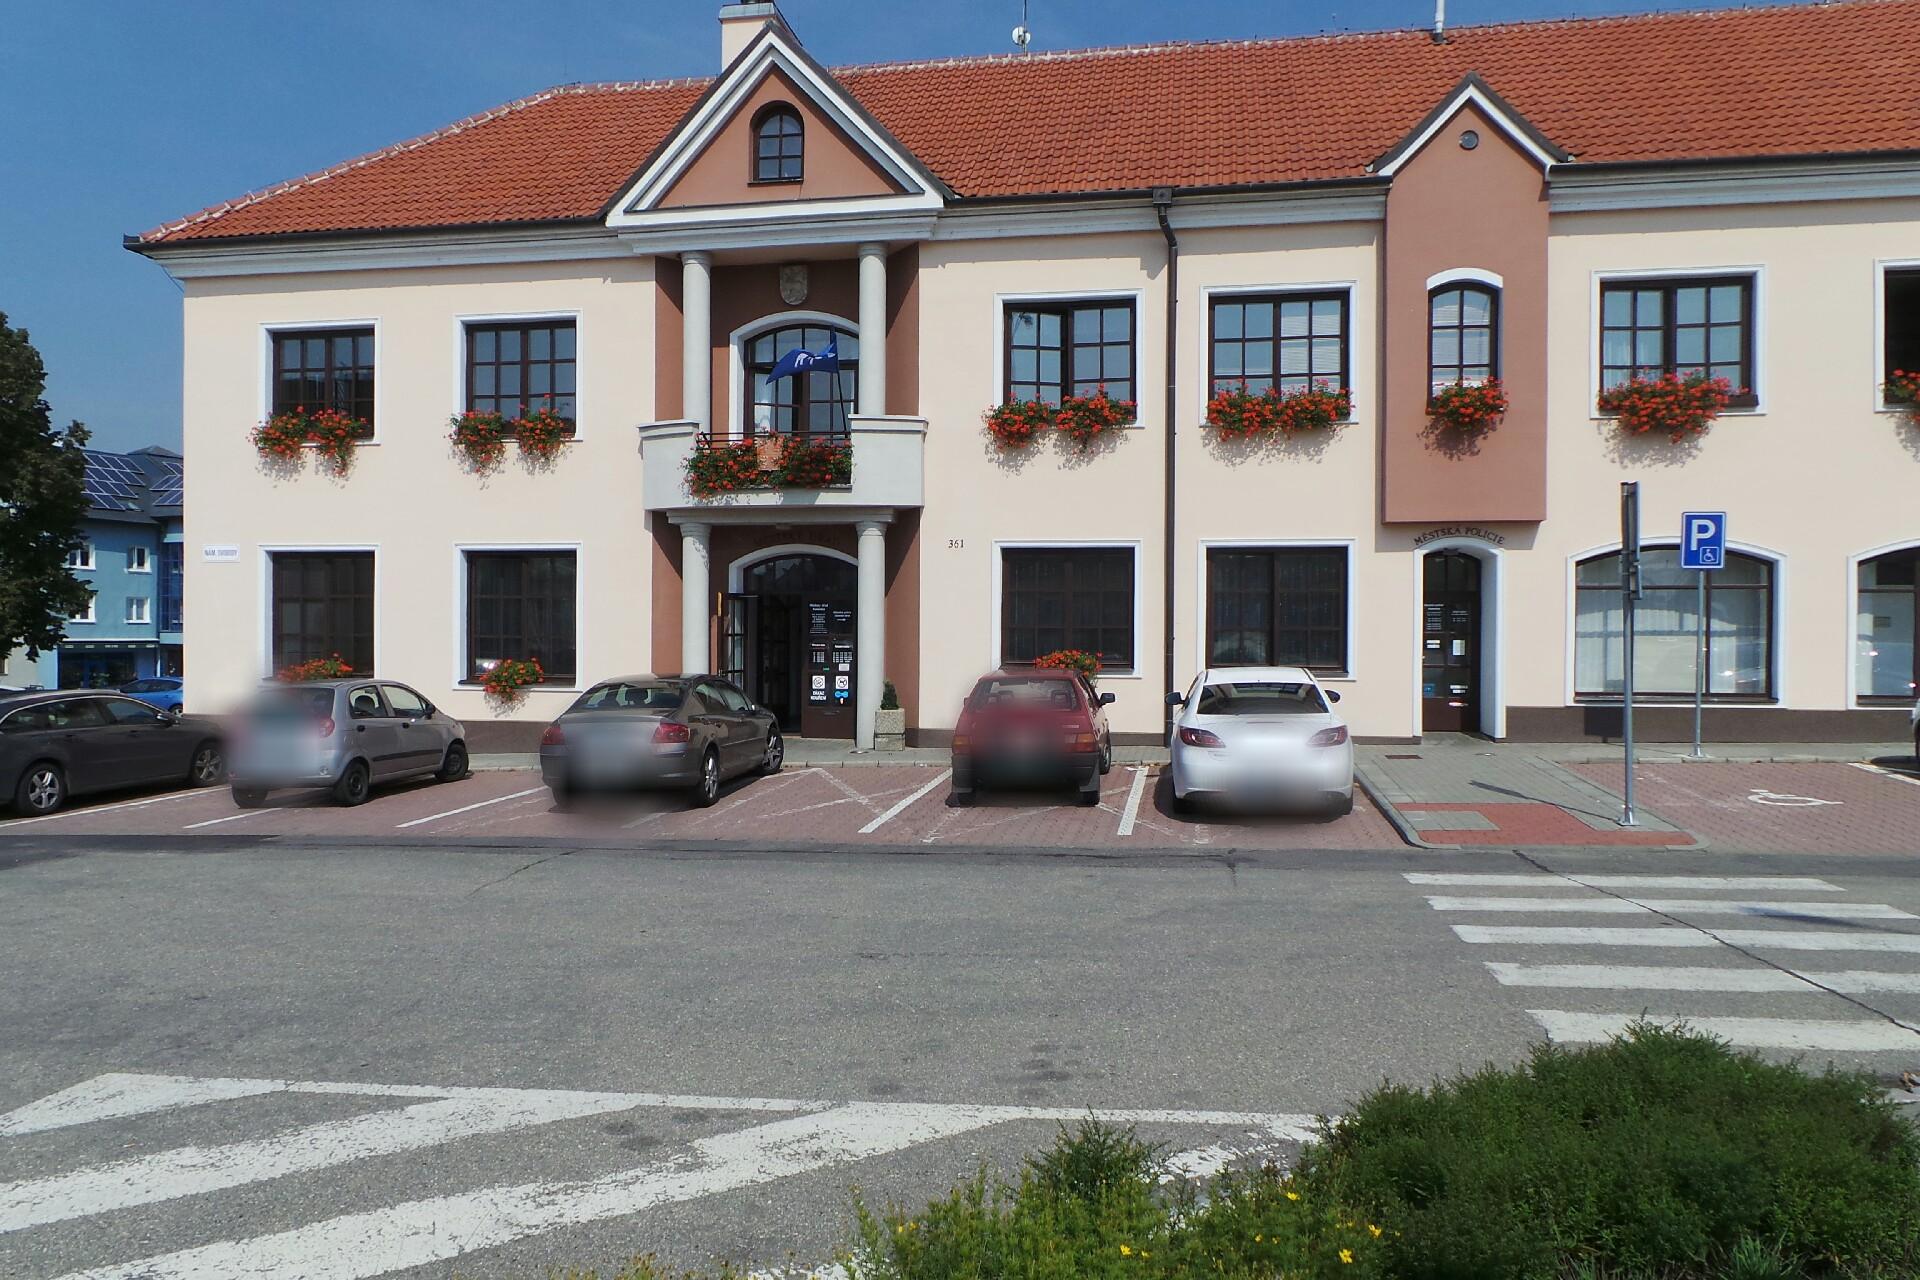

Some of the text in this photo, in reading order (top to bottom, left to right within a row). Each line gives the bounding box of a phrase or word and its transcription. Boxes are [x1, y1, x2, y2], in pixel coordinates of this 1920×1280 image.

[948, 539, 964, 549] 361
[1464, 527, 1505, 545] POLICIE
[1690, 519, 1716, 551] P
